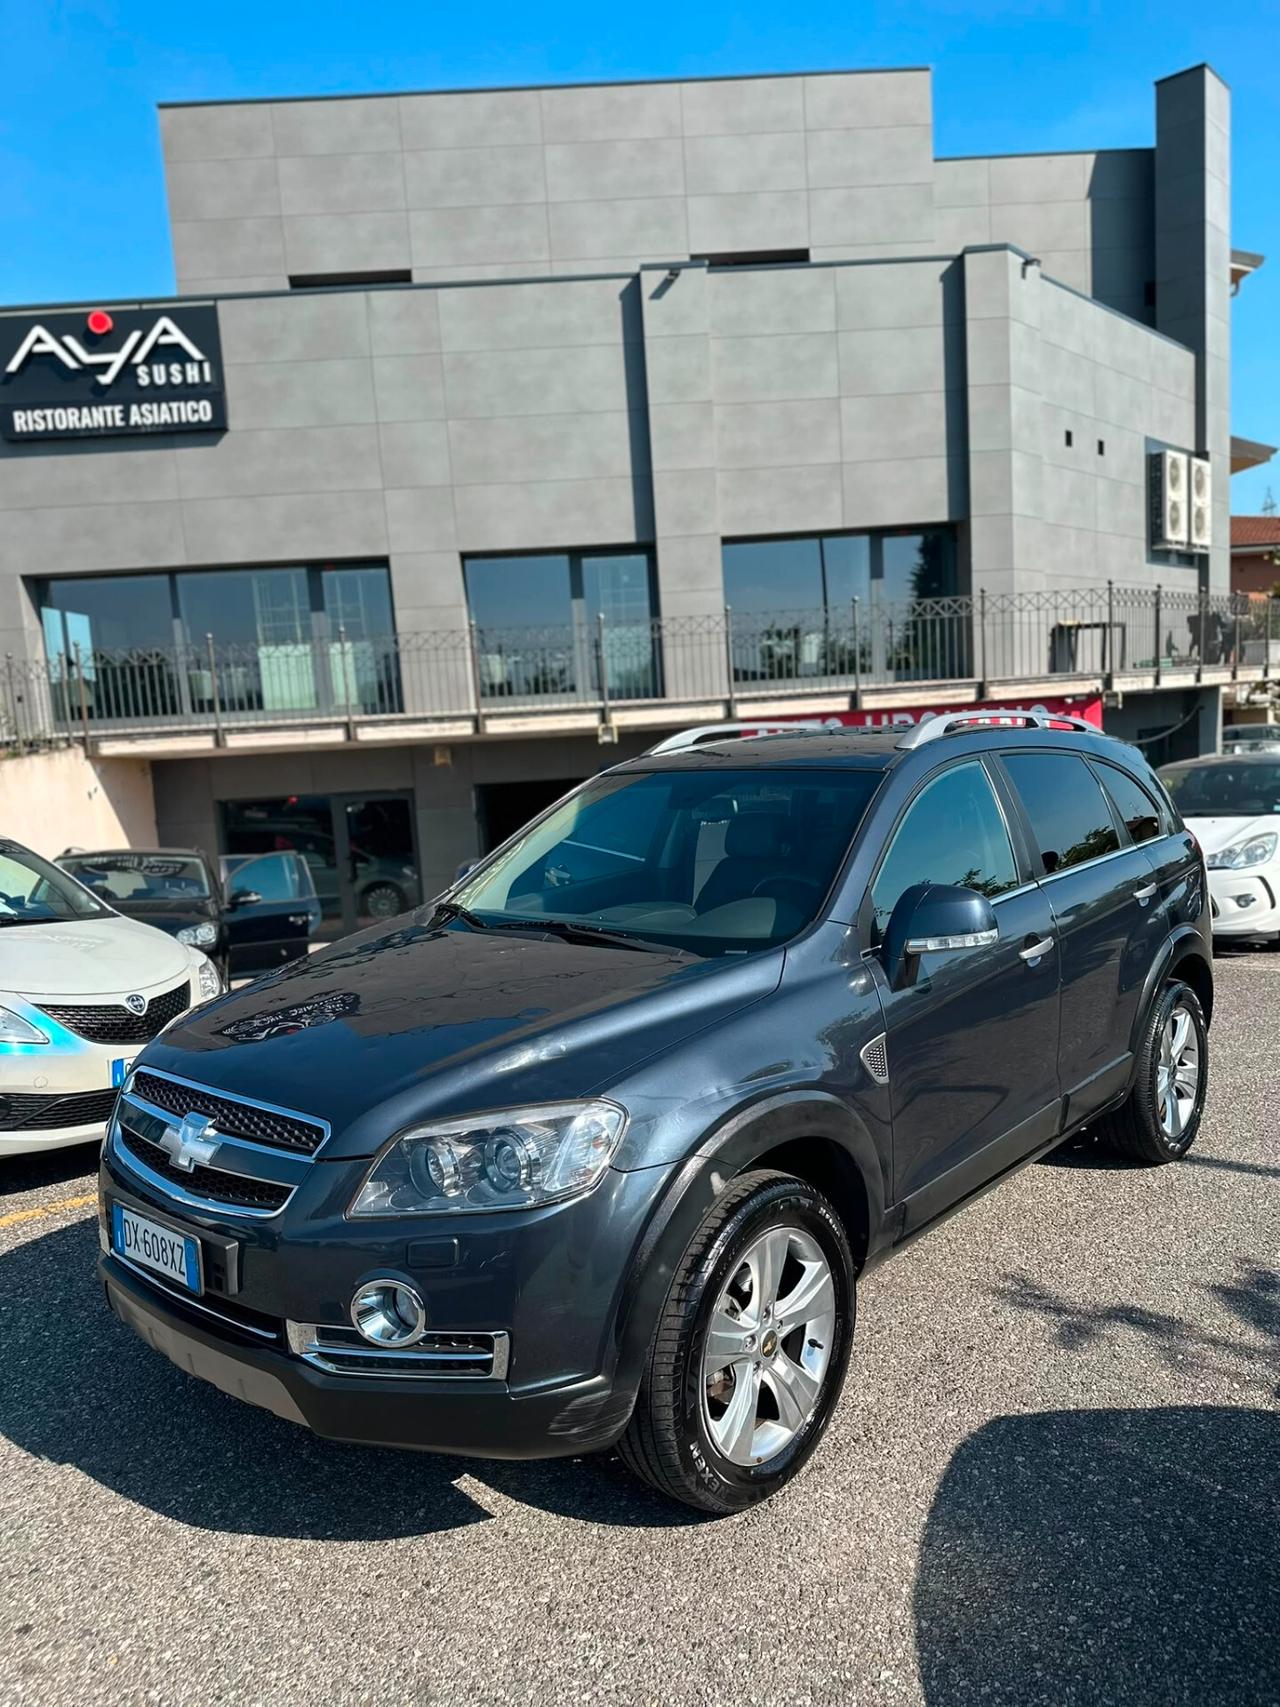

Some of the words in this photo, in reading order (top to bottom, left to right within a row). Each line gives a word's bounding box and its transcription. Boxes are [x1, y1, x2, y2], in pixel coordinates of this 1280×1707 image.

[5, 316, 206, 385] AYA
[137, 361, 212, 386] SUSHI
[13, 404, 125, 433] RISTORANTE
[129, 400, 212, 426] ASIATICO
[689, 1441, 729, 1500] NEXEN
